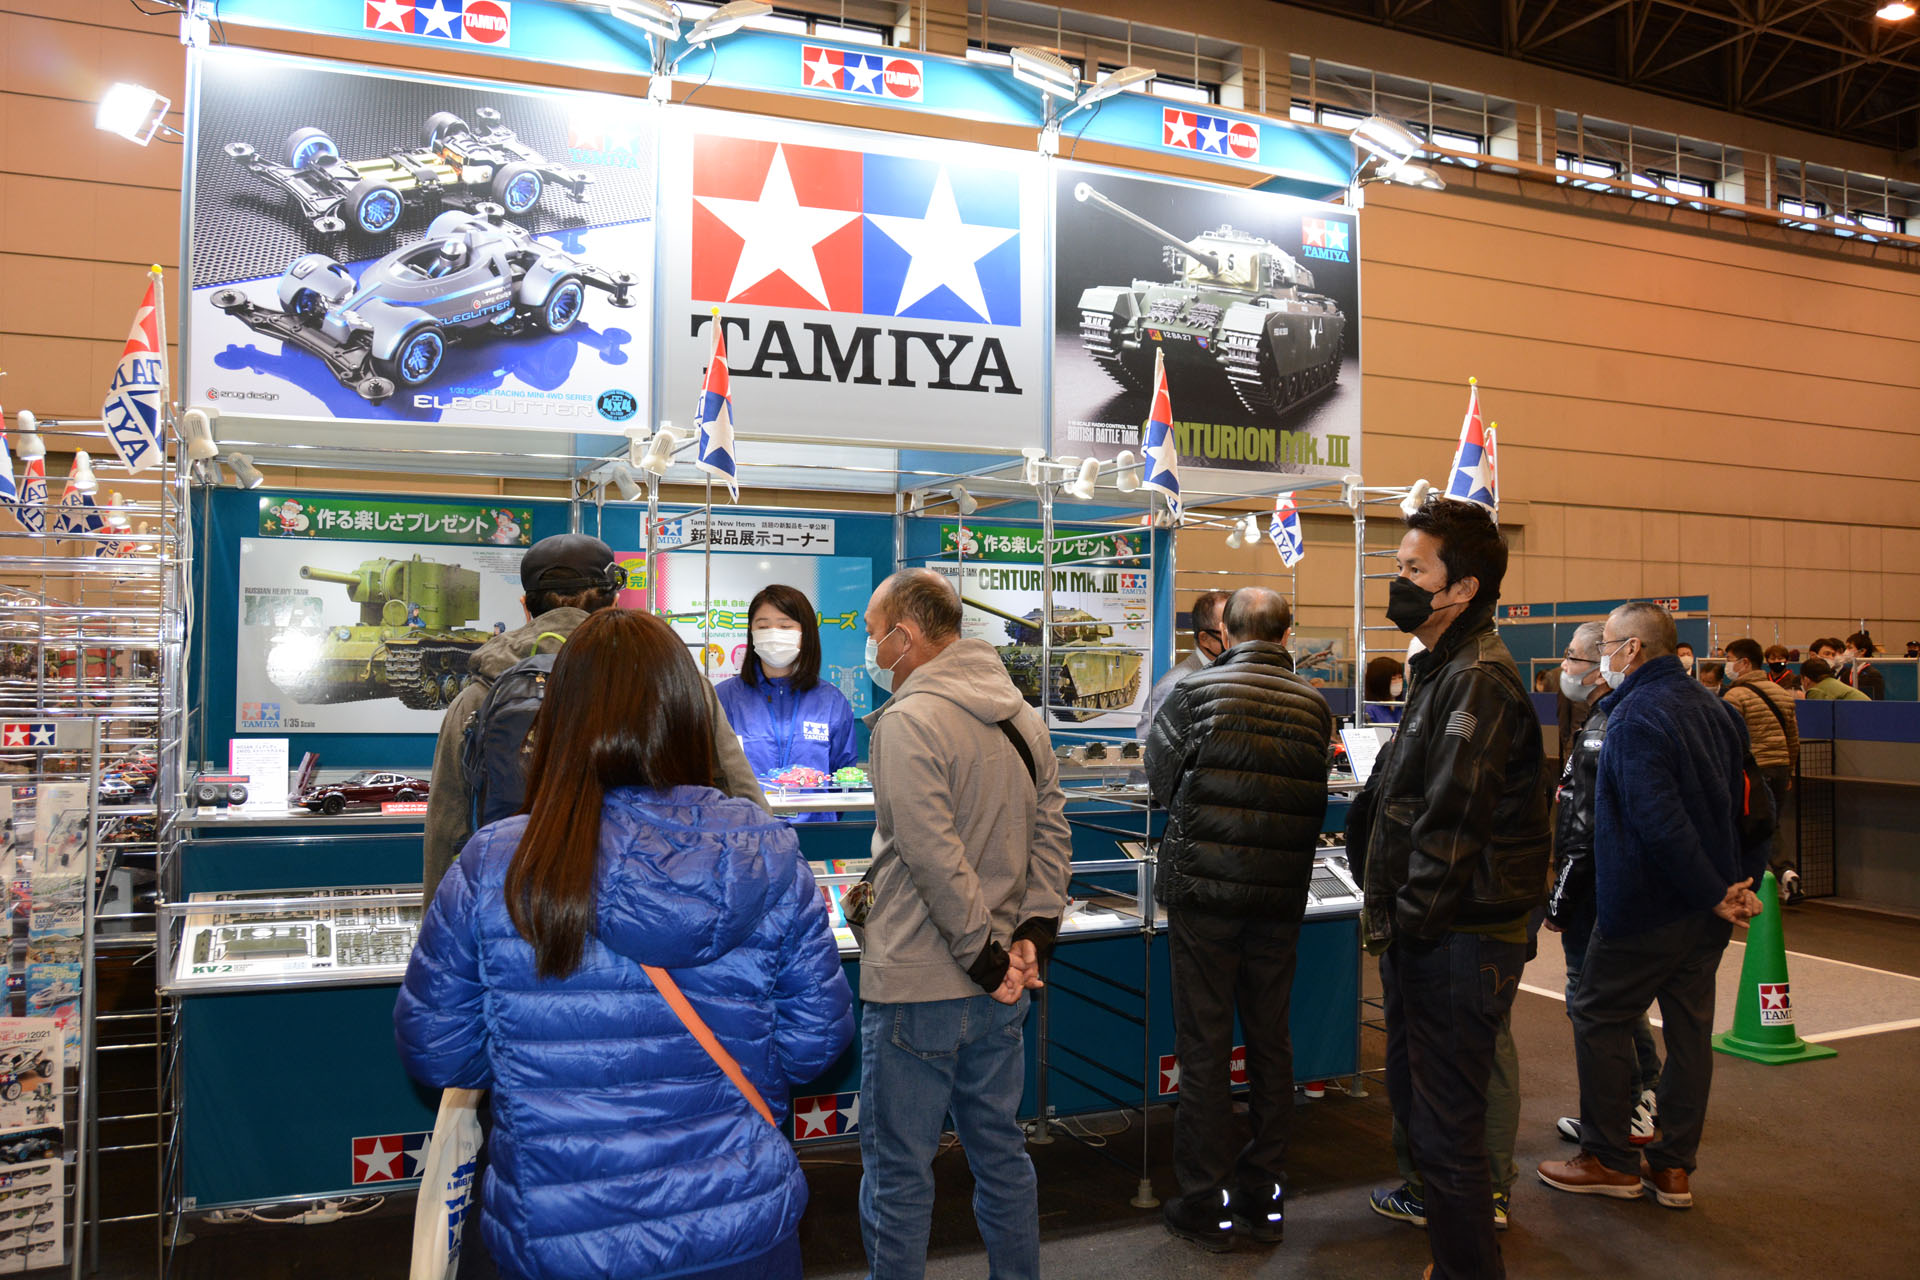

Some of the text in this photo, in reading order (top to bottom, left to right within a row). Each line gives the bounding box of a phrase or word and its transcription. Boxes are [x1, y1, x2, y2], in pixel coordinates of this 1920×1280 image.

[463, 12, 508, 33] TAMIYA
[884, 70, 921, 88] TAMIYA
[1229, 132, 1258, 149] TAMIYA
[567, 147, 640, 169] TAMIYA
[1302, 245, 1350, 264] TAMIYA
[690, 314, 1023, 395] TAMIYA
[467, 388, 492, 396] SCALE
[494, 389, 525, 398] RACING
[527, 391, 545, 399] MINI
[565, 393, 593, 402] SERIES
[413, 395, 594, 418] ELEGLITTER
[1095, 427, 1120, 444] BATTLE
[1121, 430, 1139, 446] TANK
[317, 508, 489, 535] 作る楽しさプレゼント
[718, 520, 734, 528] New
[690, 528, 830, 547] 新製品展示コーナー
[241, 720, 280, 728] TAMIYA
[284, 718, 300, 728] 1/35
